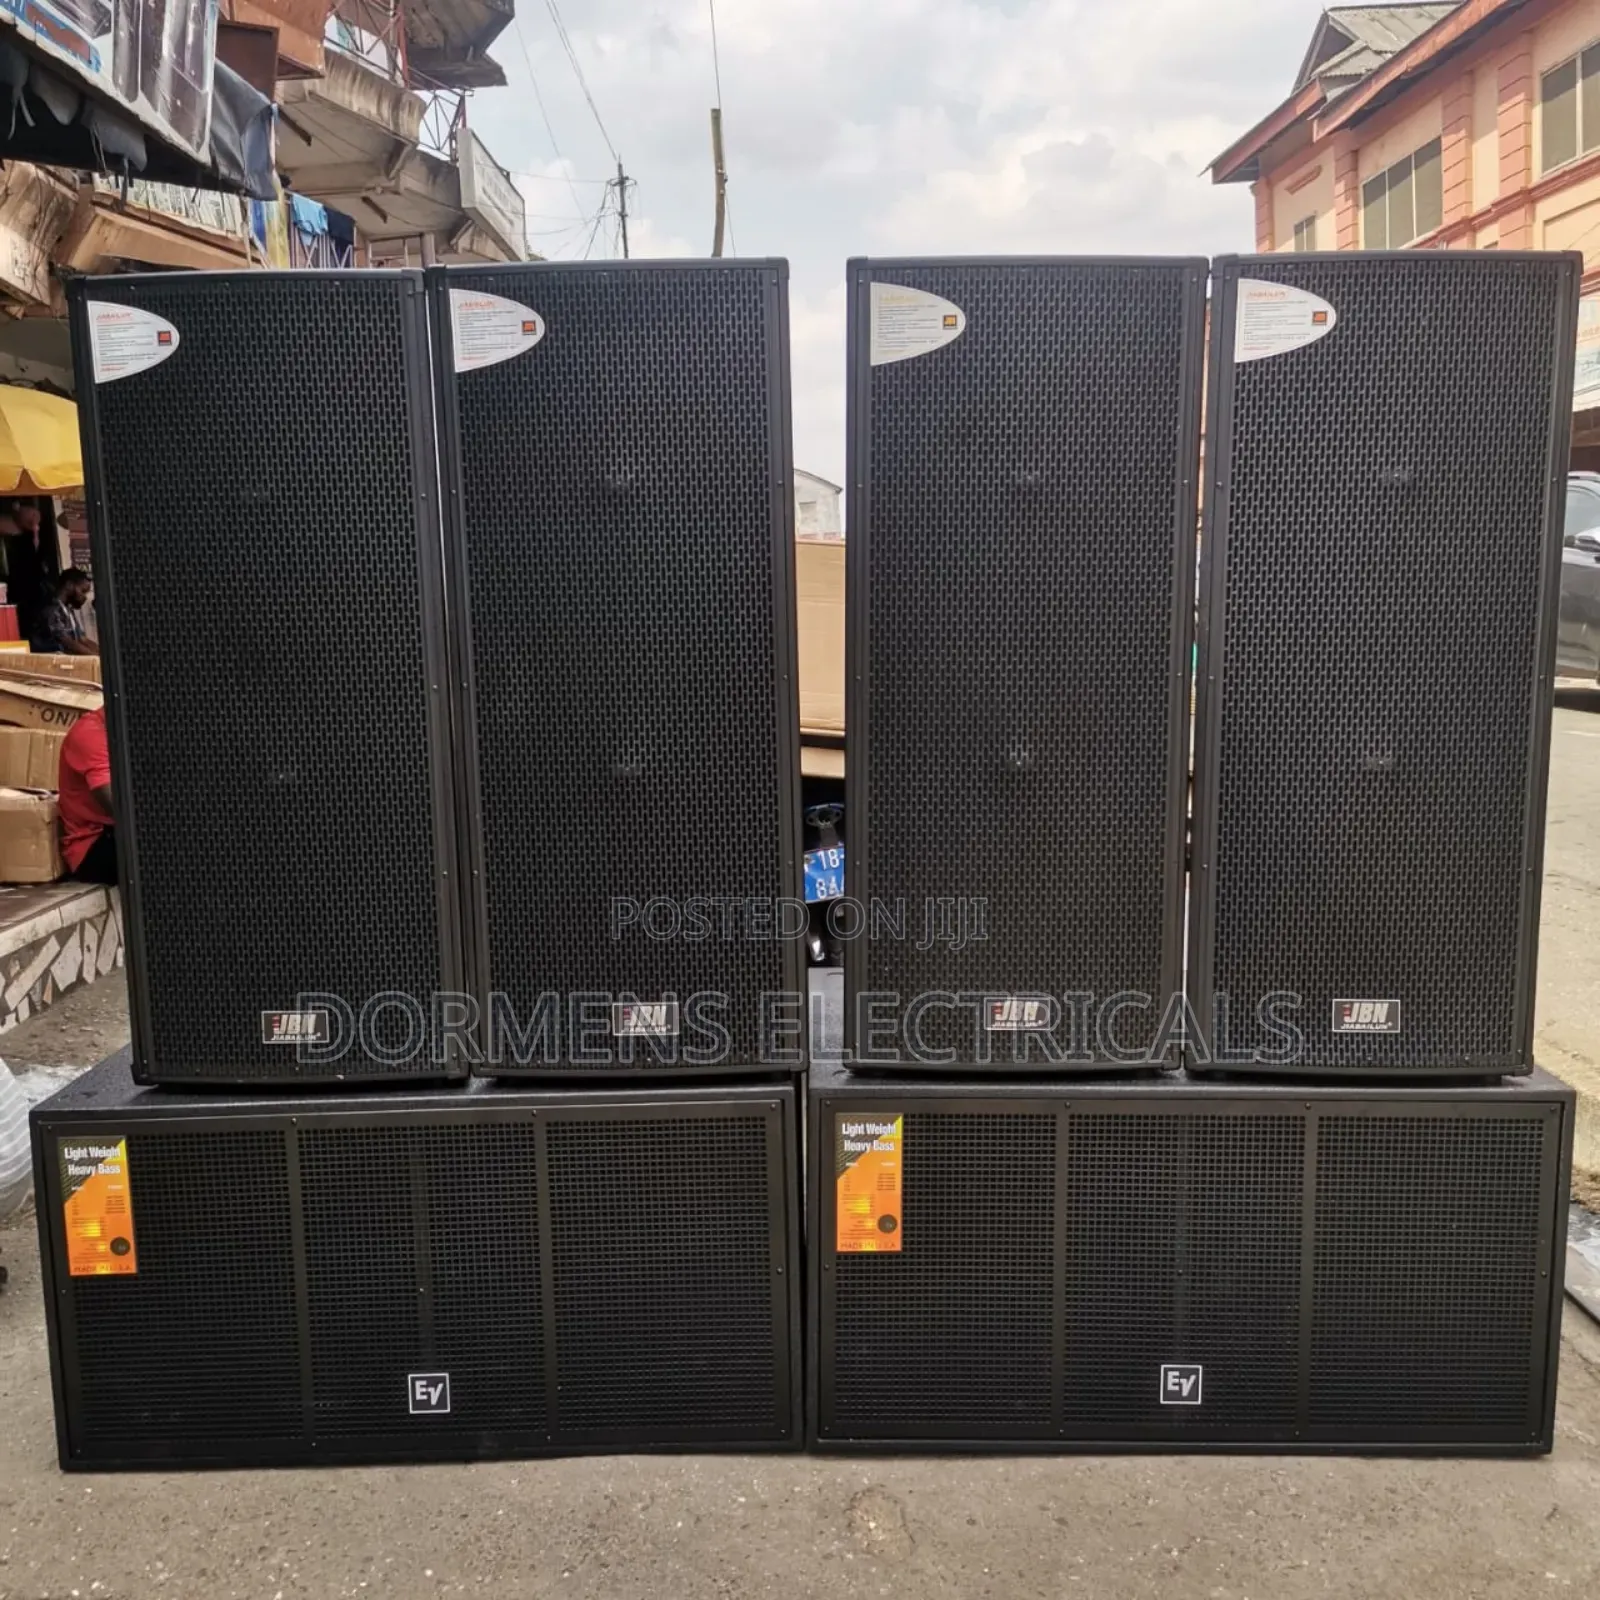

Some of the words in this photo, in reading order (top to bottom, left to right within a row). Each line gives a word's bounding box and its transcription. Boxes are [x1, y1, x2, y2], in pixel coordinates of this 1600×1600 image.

[623, 1005, 667, 1026] JBN
[993, 1001, 1039, 1021] JBN
[1342, 1003, 1389, 1023] JBN
[272, 1014, 317, 1034] JBN
[842, 1123, 865, 1137] Light
[64, 1147, 88, 1160] Light
[844, 1140, 871, 1152] Heavy
[873, 1140, 895, 1151] Bass
[68, 1164, 96, 1176] Heavy
[98, 1163, 120, 1174] Bass
